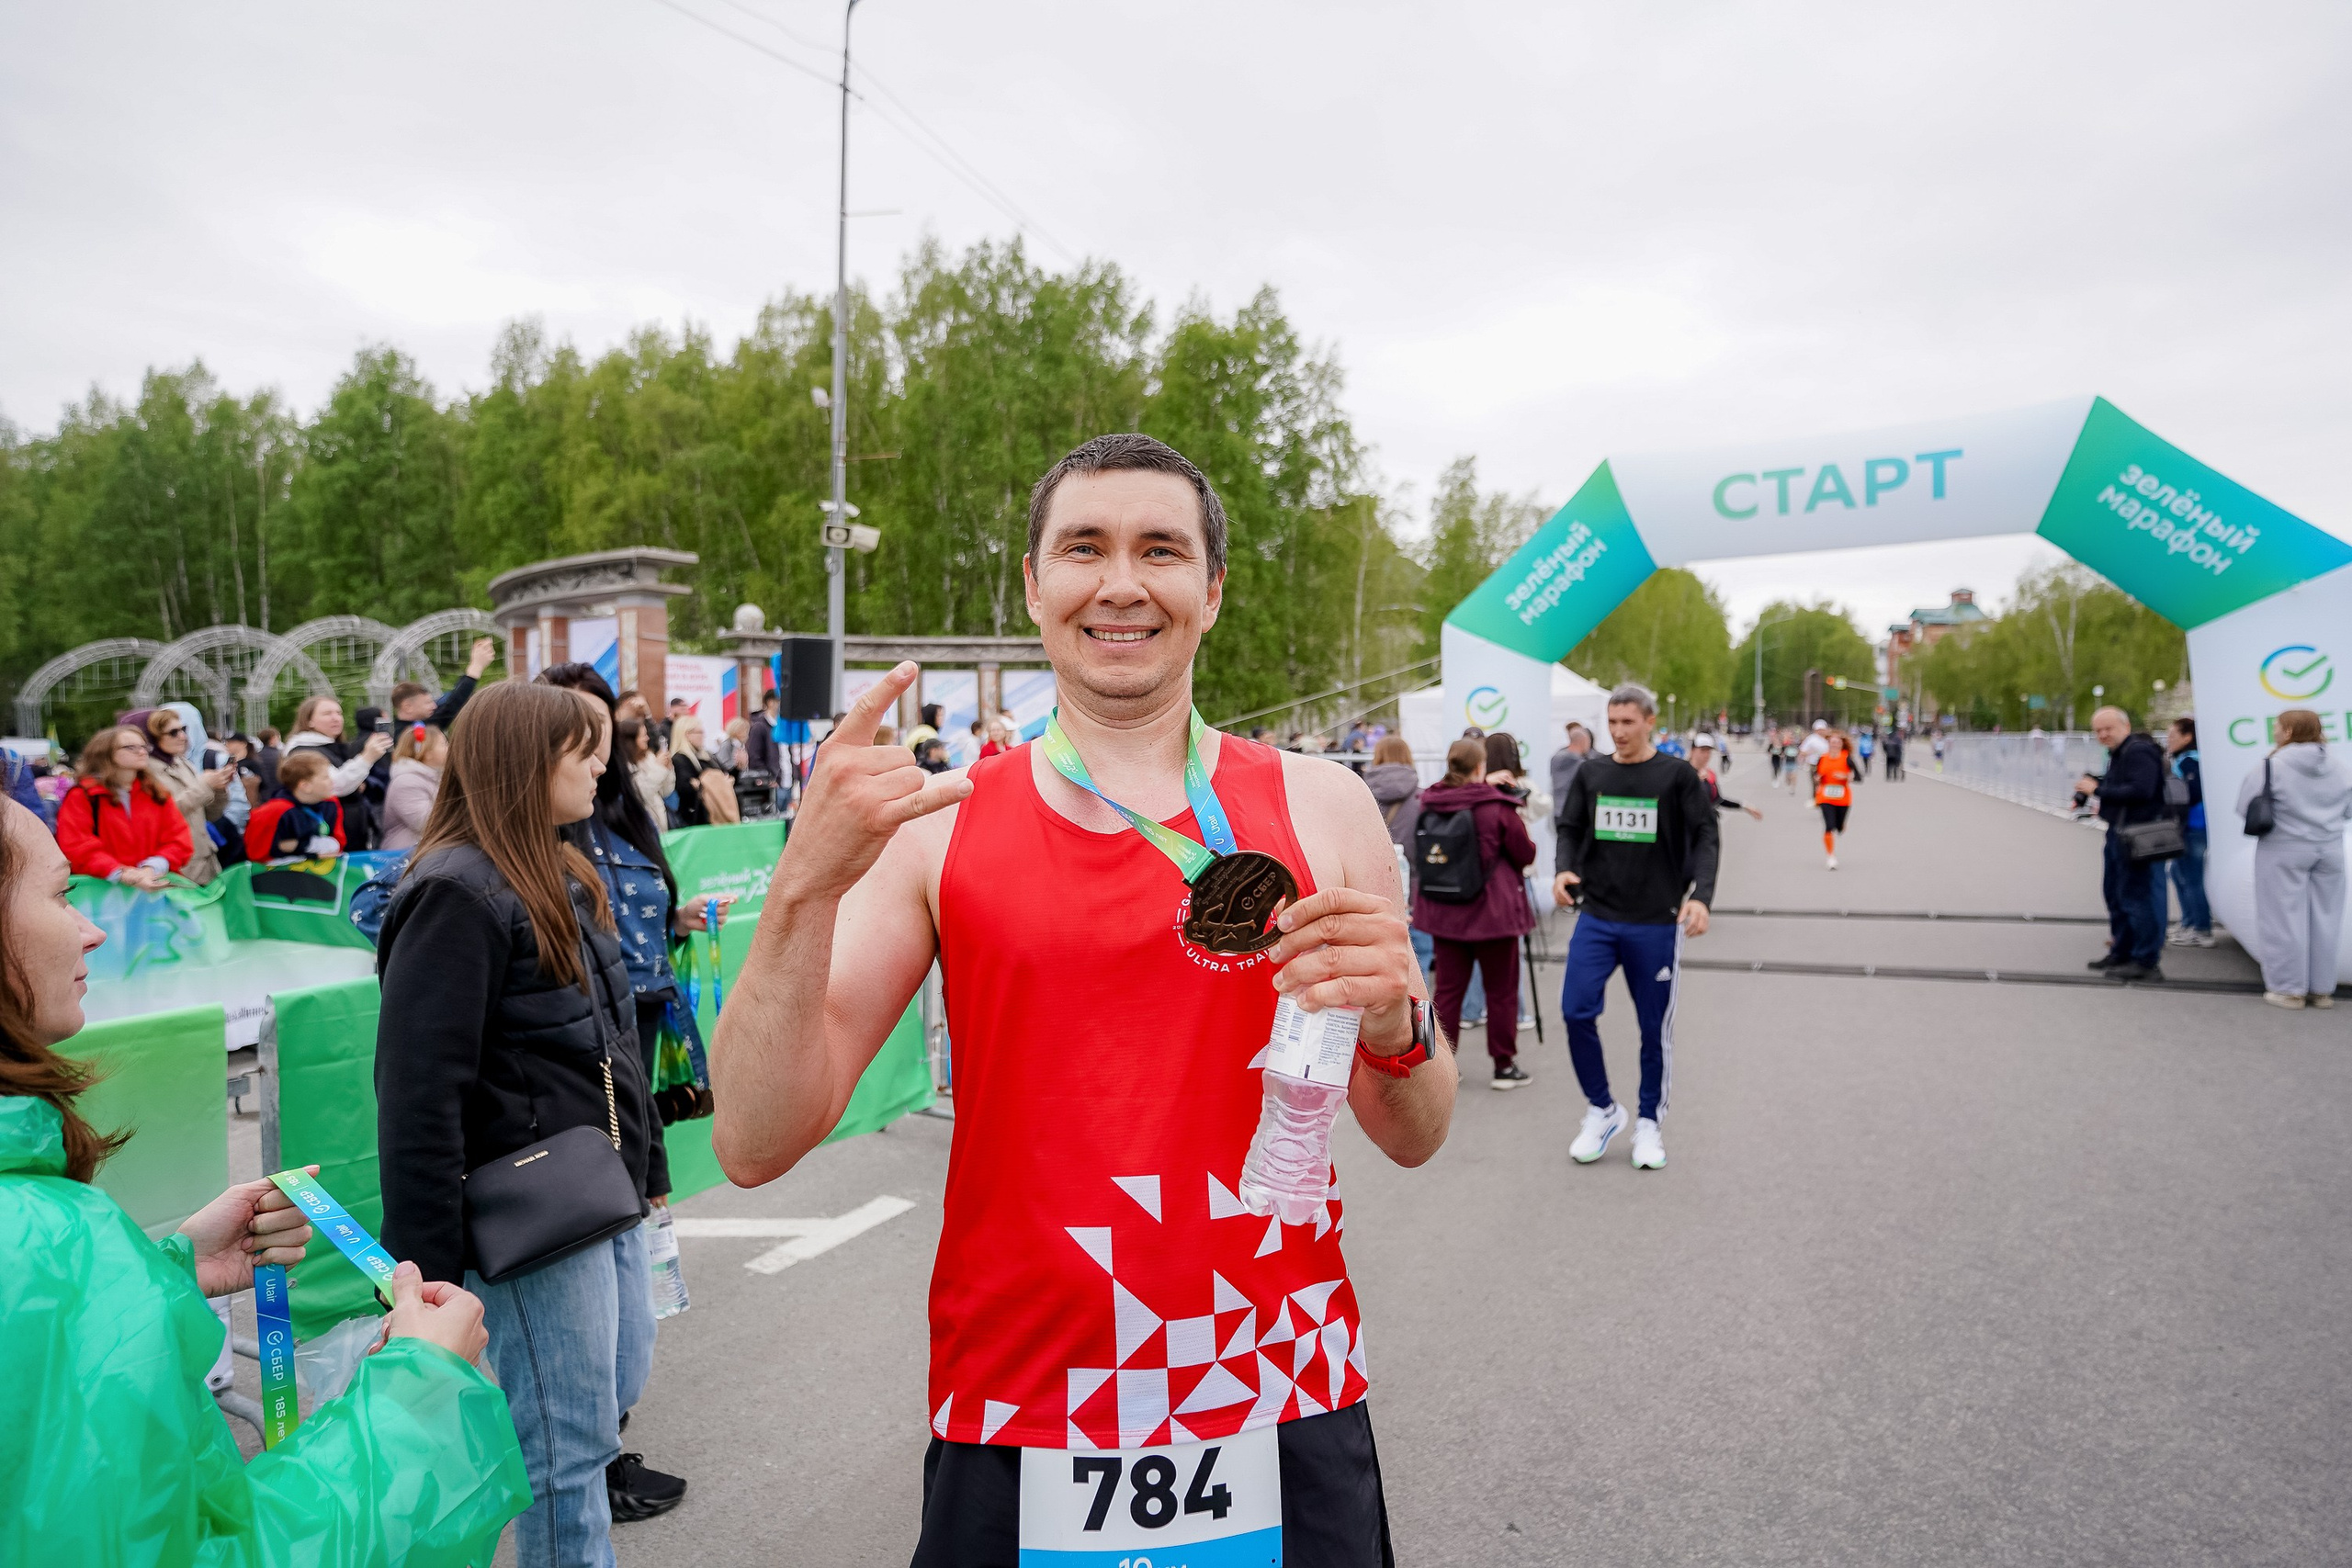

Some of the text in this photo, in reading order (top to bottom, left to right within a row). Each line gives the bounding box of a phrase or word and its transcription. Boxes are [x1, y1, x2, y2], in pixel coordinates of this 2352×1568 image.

[1712, 447, 1963, 521] СТАРТ
[2118, 463, 2261, 555] зелёный
[2096, 484, 2233, 576] марафон
[1504, 520, 1592, 611] зелёный
[1518, 537, 1607, 626] марафон
[1207, 814, 1221, 835] Utair
[1604, 811, 1647, 829] 1131
[1252, 872, 1277, 898] СБЕР
[1185, 947, 1231, 973] ULTRA
[299, 1190, 322, 1206] СБЕР
[367, 1255, 390, 1273] СБЕР
[266, 1279, 277, 1303] Utair
[270, 1348, 284, 1382] СБЕР
[275, 1395, 286, 1418] 185
[1072, 1445, 1233, 1533] 784
